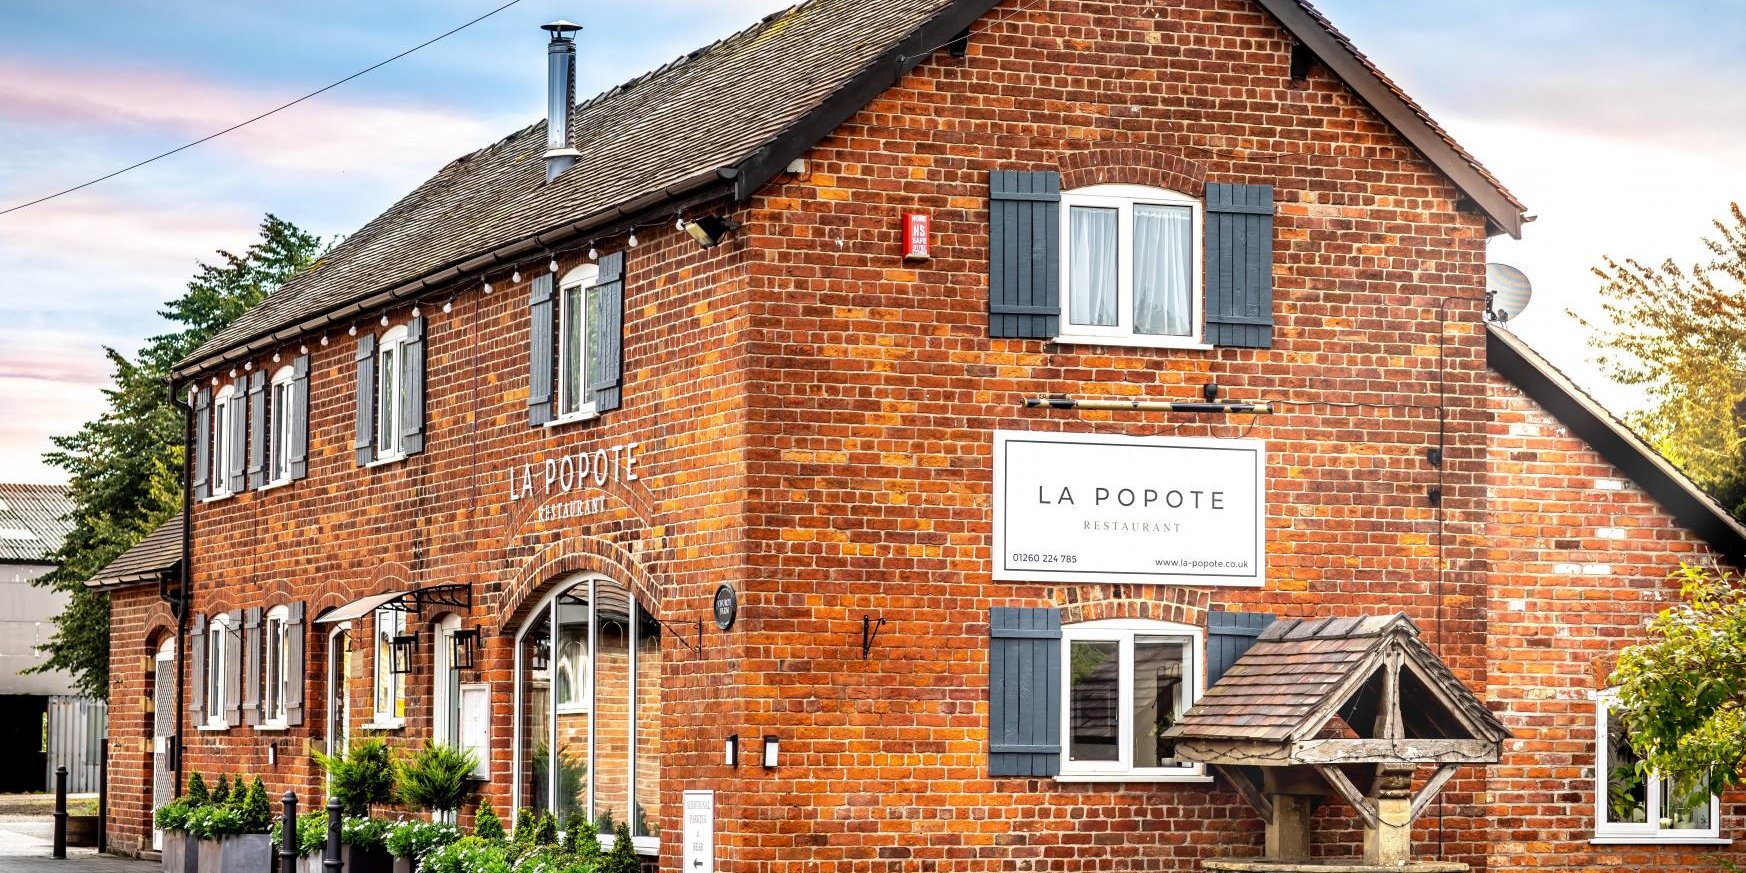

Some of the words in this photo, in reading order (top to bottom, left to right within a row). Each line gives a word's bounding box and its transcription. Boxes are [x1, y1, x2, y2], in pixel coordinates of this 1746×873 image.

[913, 224, 926, 236] HS
[510, 462, 533, 500] LA
[545, 442, 639, 495] POPOTE
[1039, 485, 1075, 505] LA
[1096, 487, 1224, 510] POPOTE
[538, 496, 606, 522] RESTAURANT
[1083, 520, 1181, 533] RESTAURANT
[1012, 553, 1040, 563] 01260
[1042, 554, 1059, 563] 224
[1060, 554, 1077, 564] 785
[1155, 559, 1249, 569] www.la-popote.co.uk
[689, 814, 706, 824] PARKING
